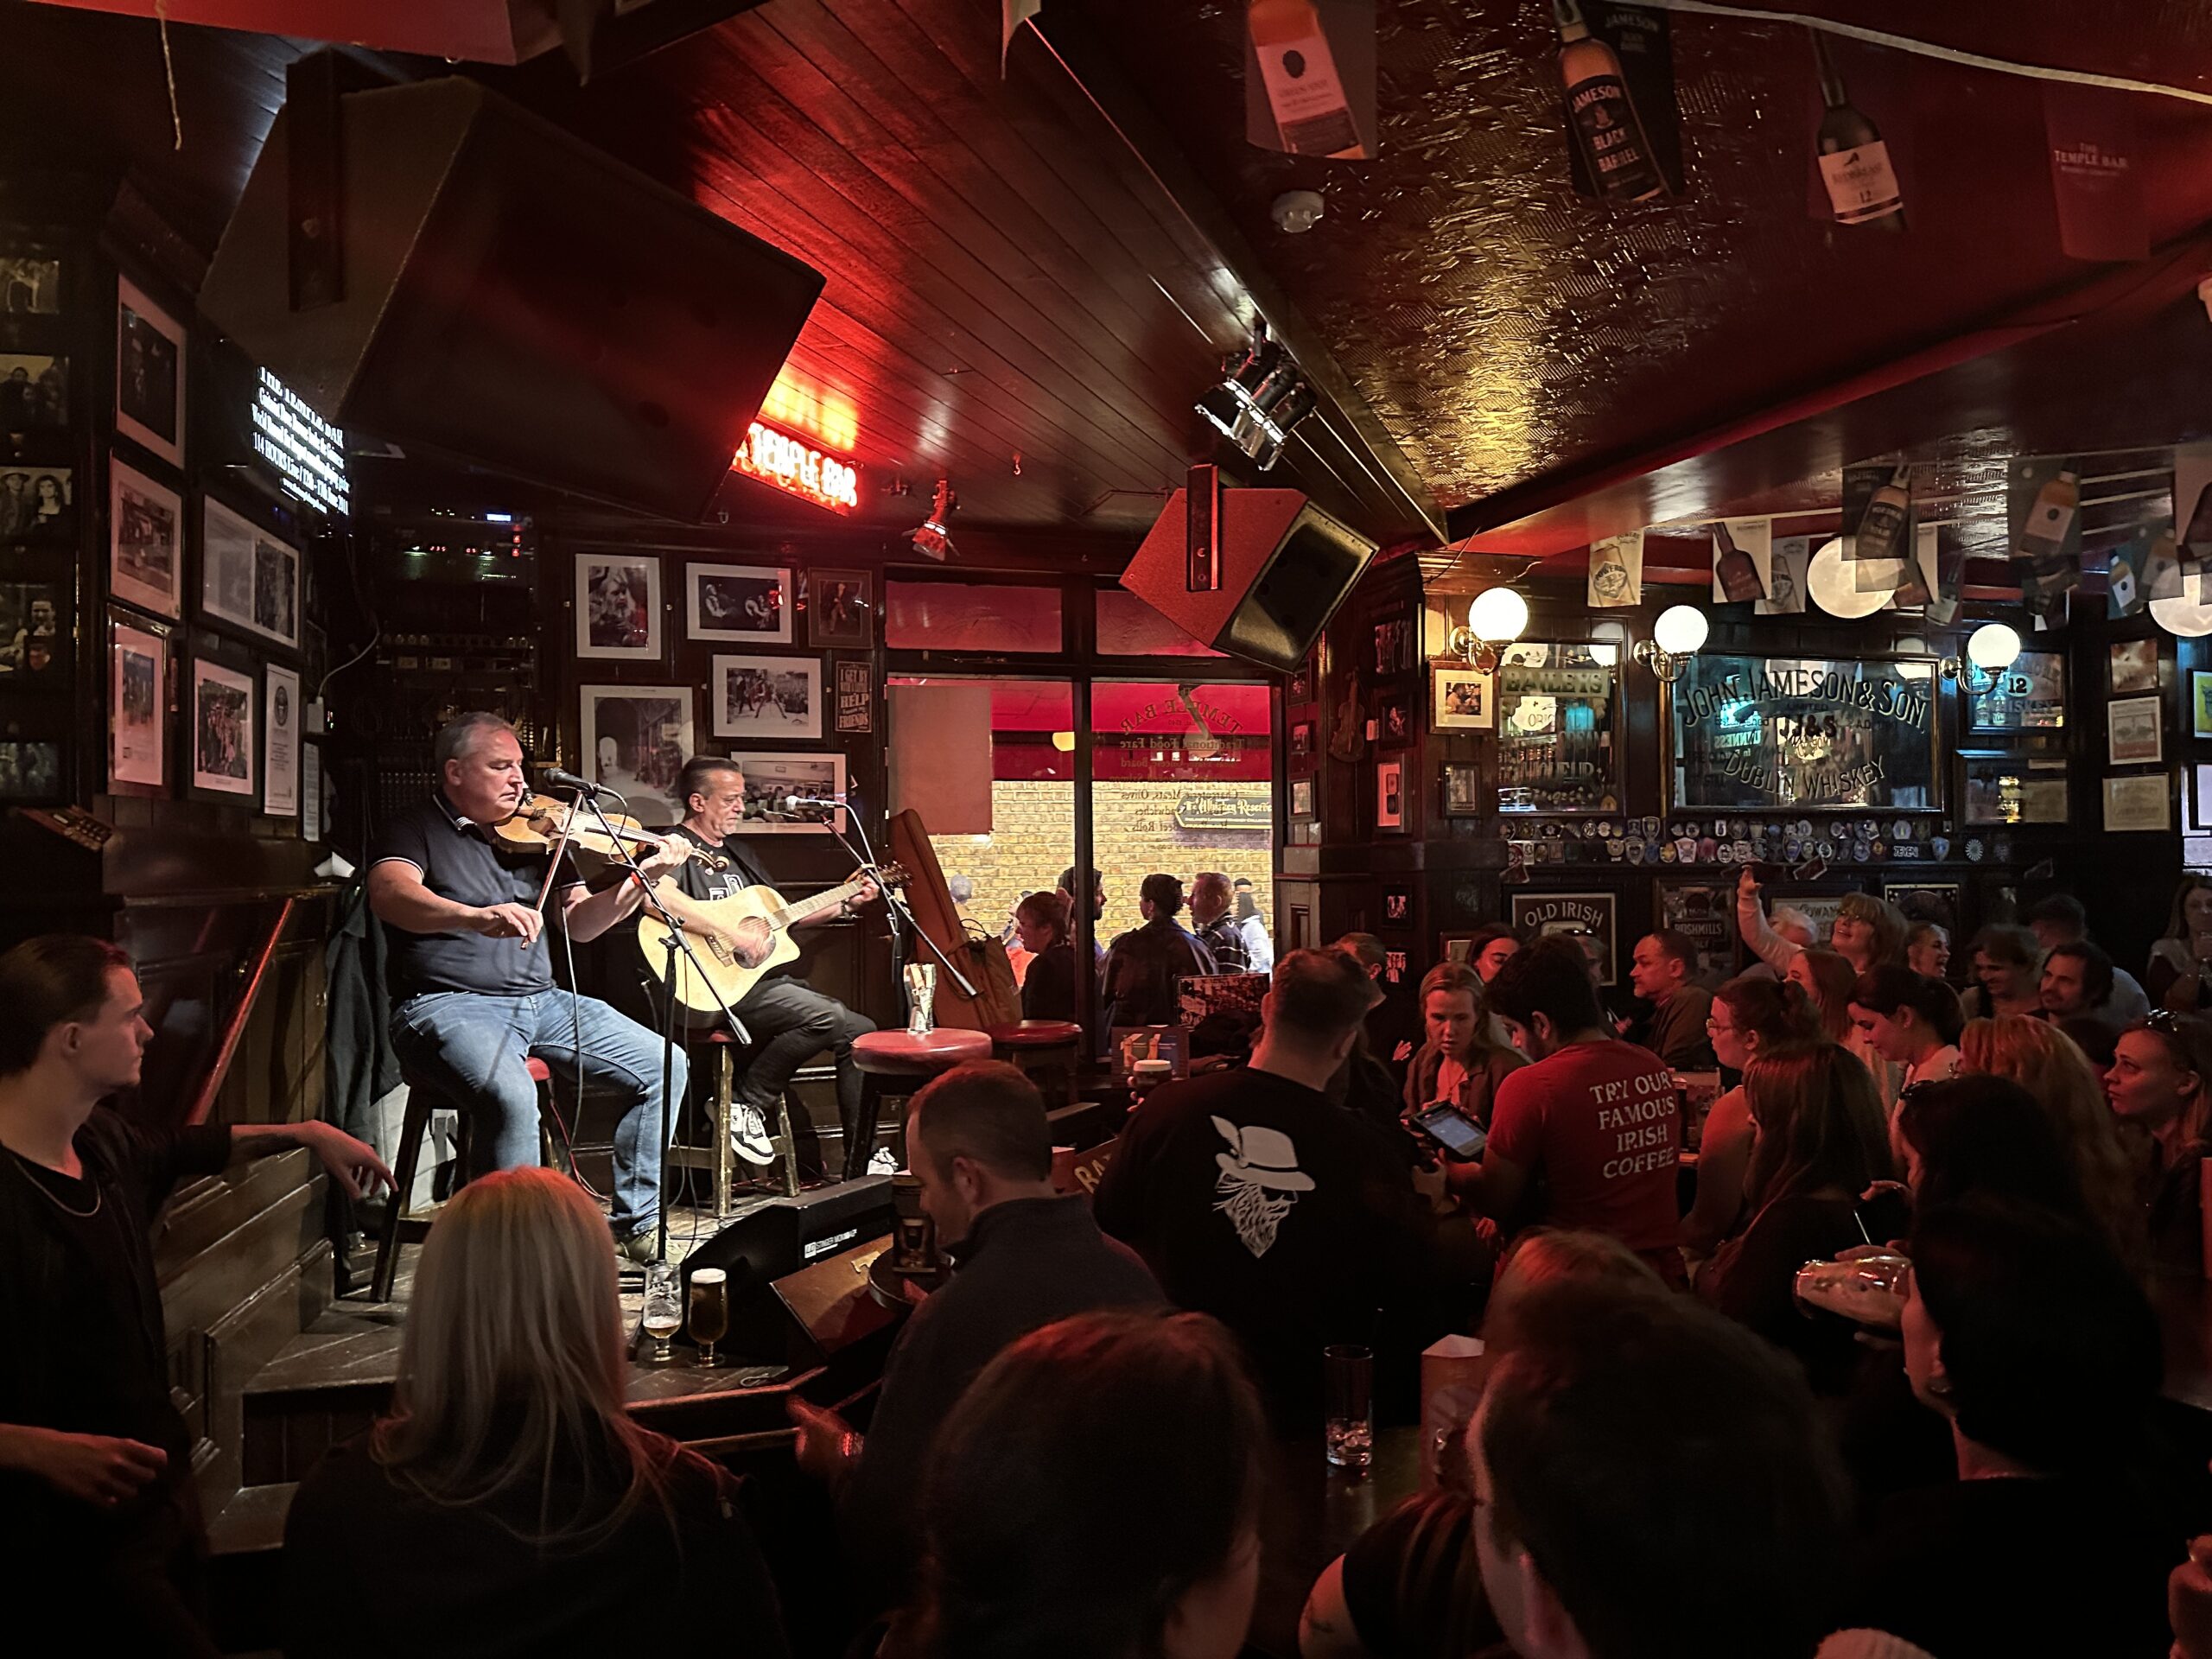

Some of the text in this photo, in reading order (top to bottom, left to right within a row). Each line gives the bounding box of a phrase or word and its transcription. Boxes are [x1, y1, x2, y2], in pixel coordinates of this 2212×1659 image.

[1572, 84, 1622, 114] JAMESON
[1592, 126, 1627, 151] BLACK
[1597, 147, 1641, 173] BARREL
[2054, 149, 2128, 168] TEMPLE BAR
[1859, 189, 1874, 204] 12
[1505, 671, 1603, 693] BAILEYS
[2008, 677, 2027, 694] 12
[840, 693, 869, 709] HELP
[1683, 676, 1740, 728] JOHN
[1744, 669, 1858, 706] JAMESON
[1858, 680, 1876, 712] &
[1724, 751, 1885, 799] DUBLIN WHISKEY
[1524, 901, 1604, 928] OLD IRISH
[1589, 1071, 1673, 1104] TRY OUR
[1598, 1096, 1675, 1130] FAMOUS
[1617, 1123, 1669, 1154] IRISH
[1602, 1146, 1675, 1179] COFFEE
